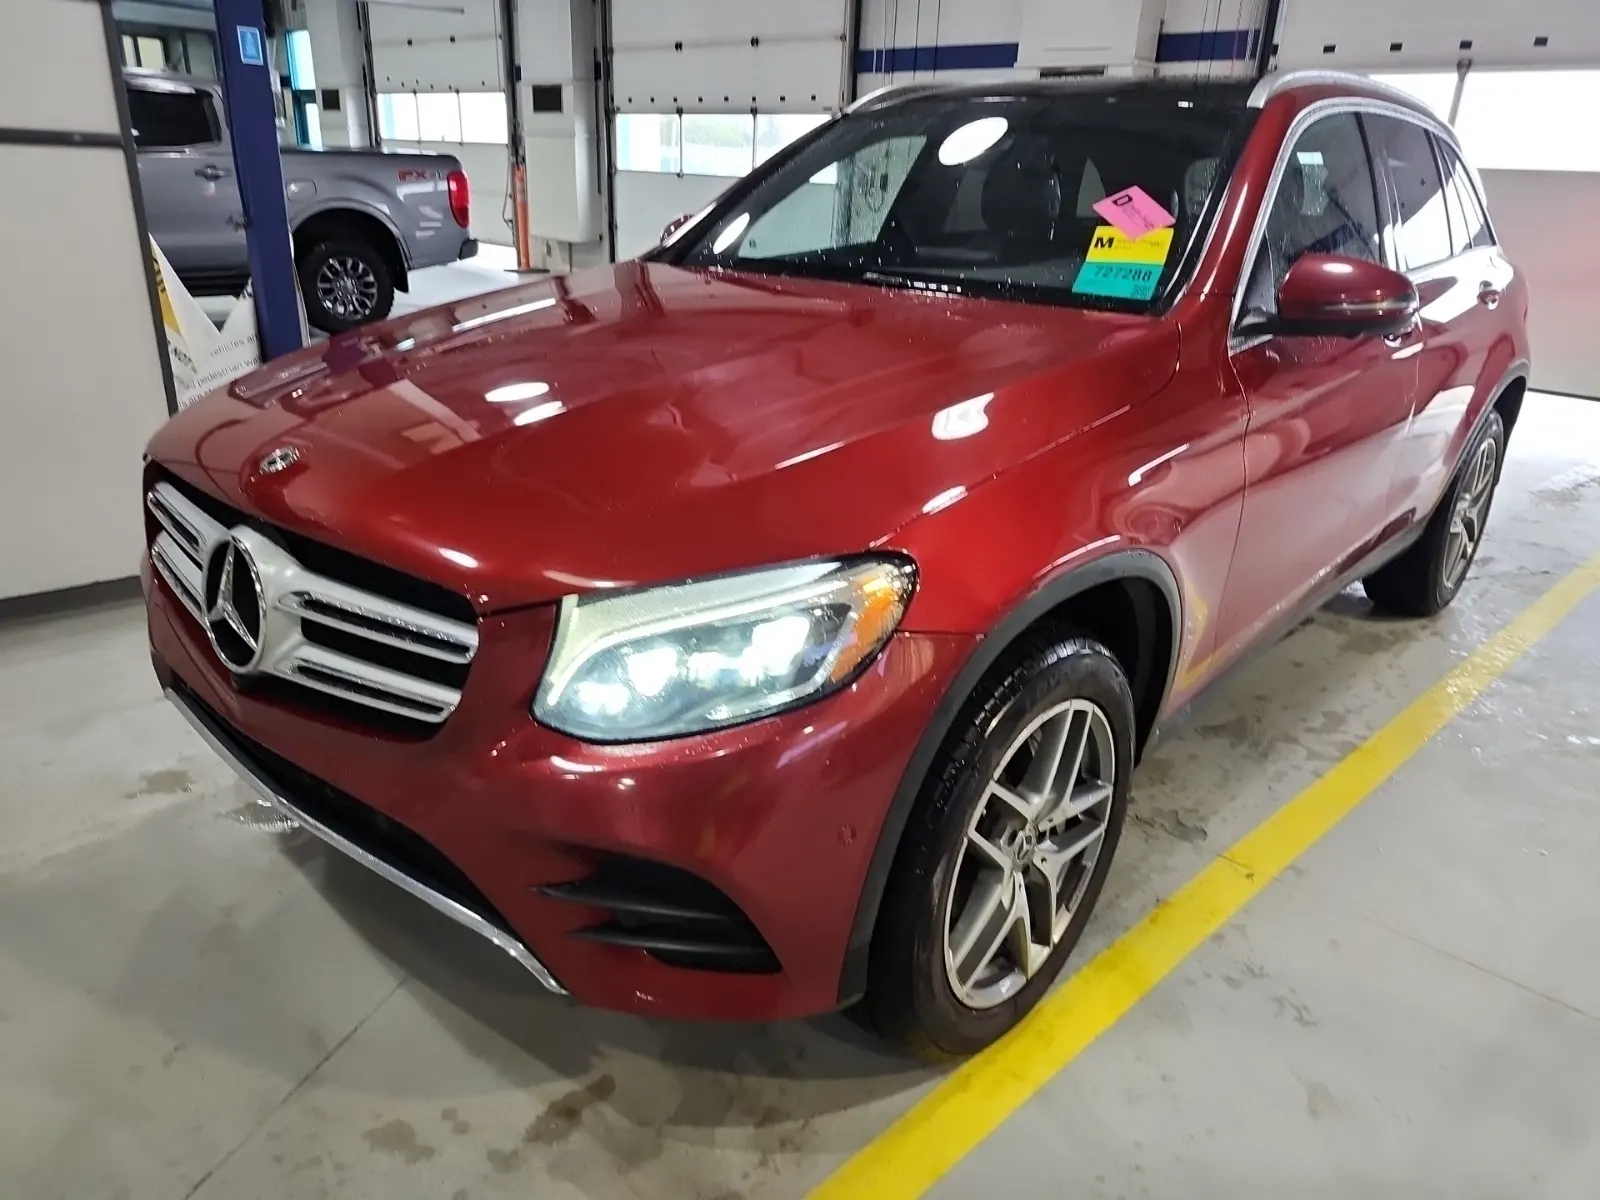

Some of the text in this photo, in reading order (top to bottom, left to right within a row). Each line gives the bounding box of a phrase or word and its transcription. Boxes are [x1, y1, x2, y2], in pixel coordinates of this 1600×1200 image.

[1112, 194, 1133, 207] D
[1094, 237, 1115, 249] M
[1094, 265, 1152, 282] 727288
[210, 339, 244, 357] vehicles
[197, 364, 243, 389] pedestrian
